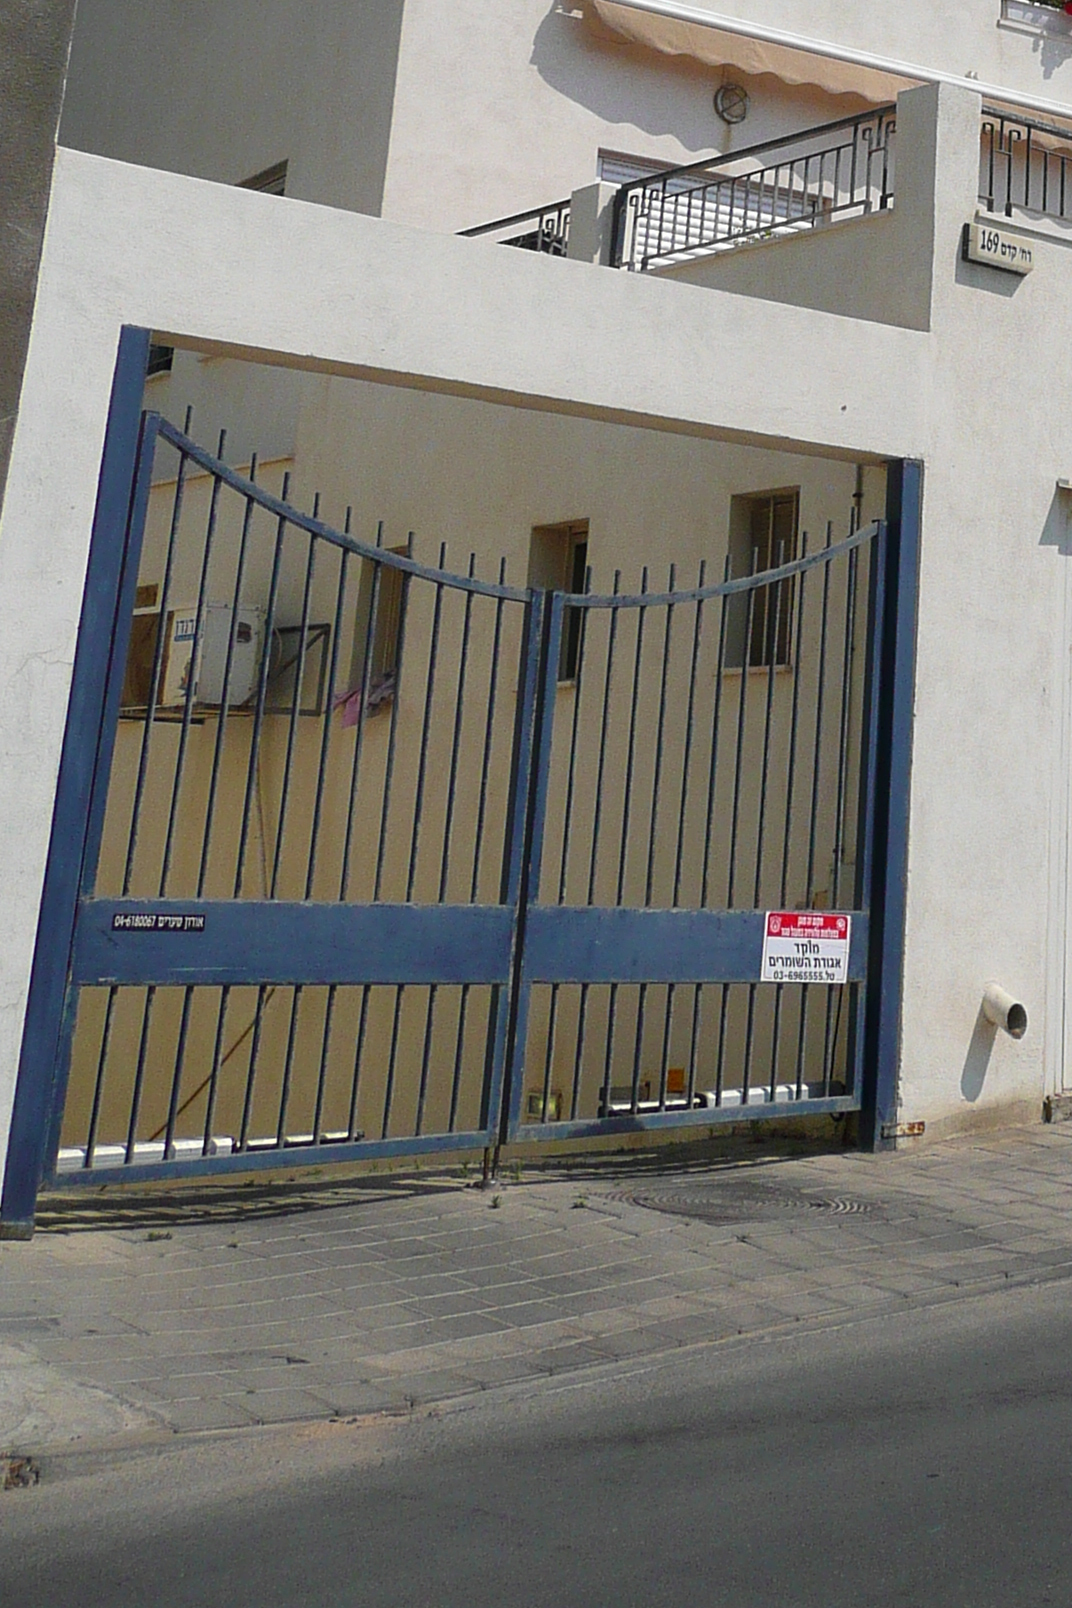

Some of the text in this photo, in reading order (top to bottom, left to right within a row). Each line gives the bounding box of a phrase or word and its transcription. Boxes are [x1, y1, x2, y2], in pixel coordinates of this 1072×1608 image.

[980, 229, 999, 254] 169
[1001, 242, 1017, 262] קדם
[794, 939, 820, 956] מוקד
[769, 955, 842, 968] אגודת השומרים
